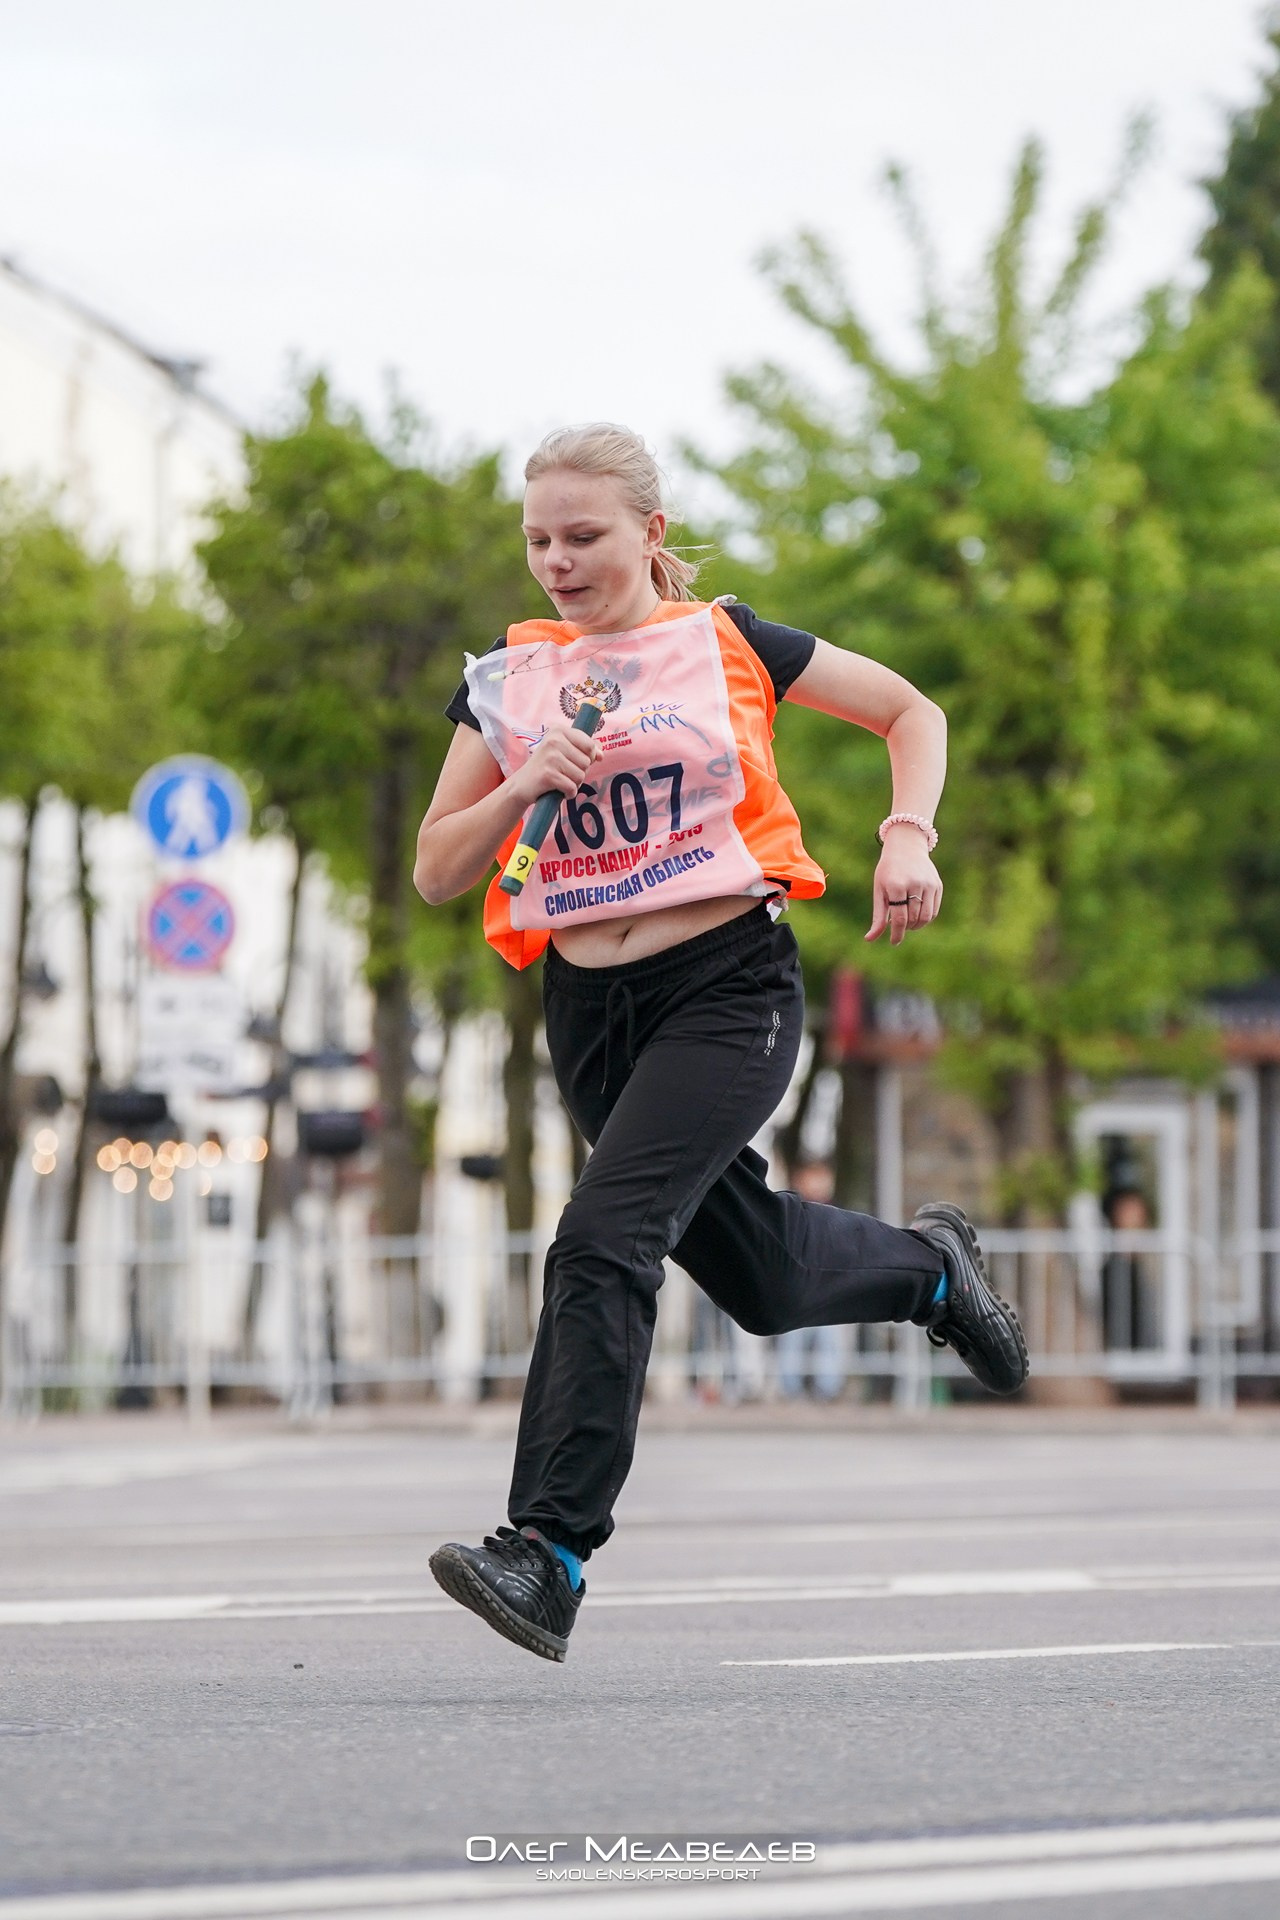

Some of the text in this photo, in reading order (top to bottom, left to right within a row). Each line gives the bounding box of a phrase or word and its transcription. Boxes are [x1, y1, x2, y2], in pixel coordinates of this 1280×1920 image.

[607, 731, 628, 741] СПОРТА
[554, 762, 684, 854] 1607
[540, 854, 597, 884] КРОСС
[598, 841, 649, 874] НАЦИИ
[545, 845, 715, 917] СМОЛЕНСКАЯ ОБЛАСТЬ
